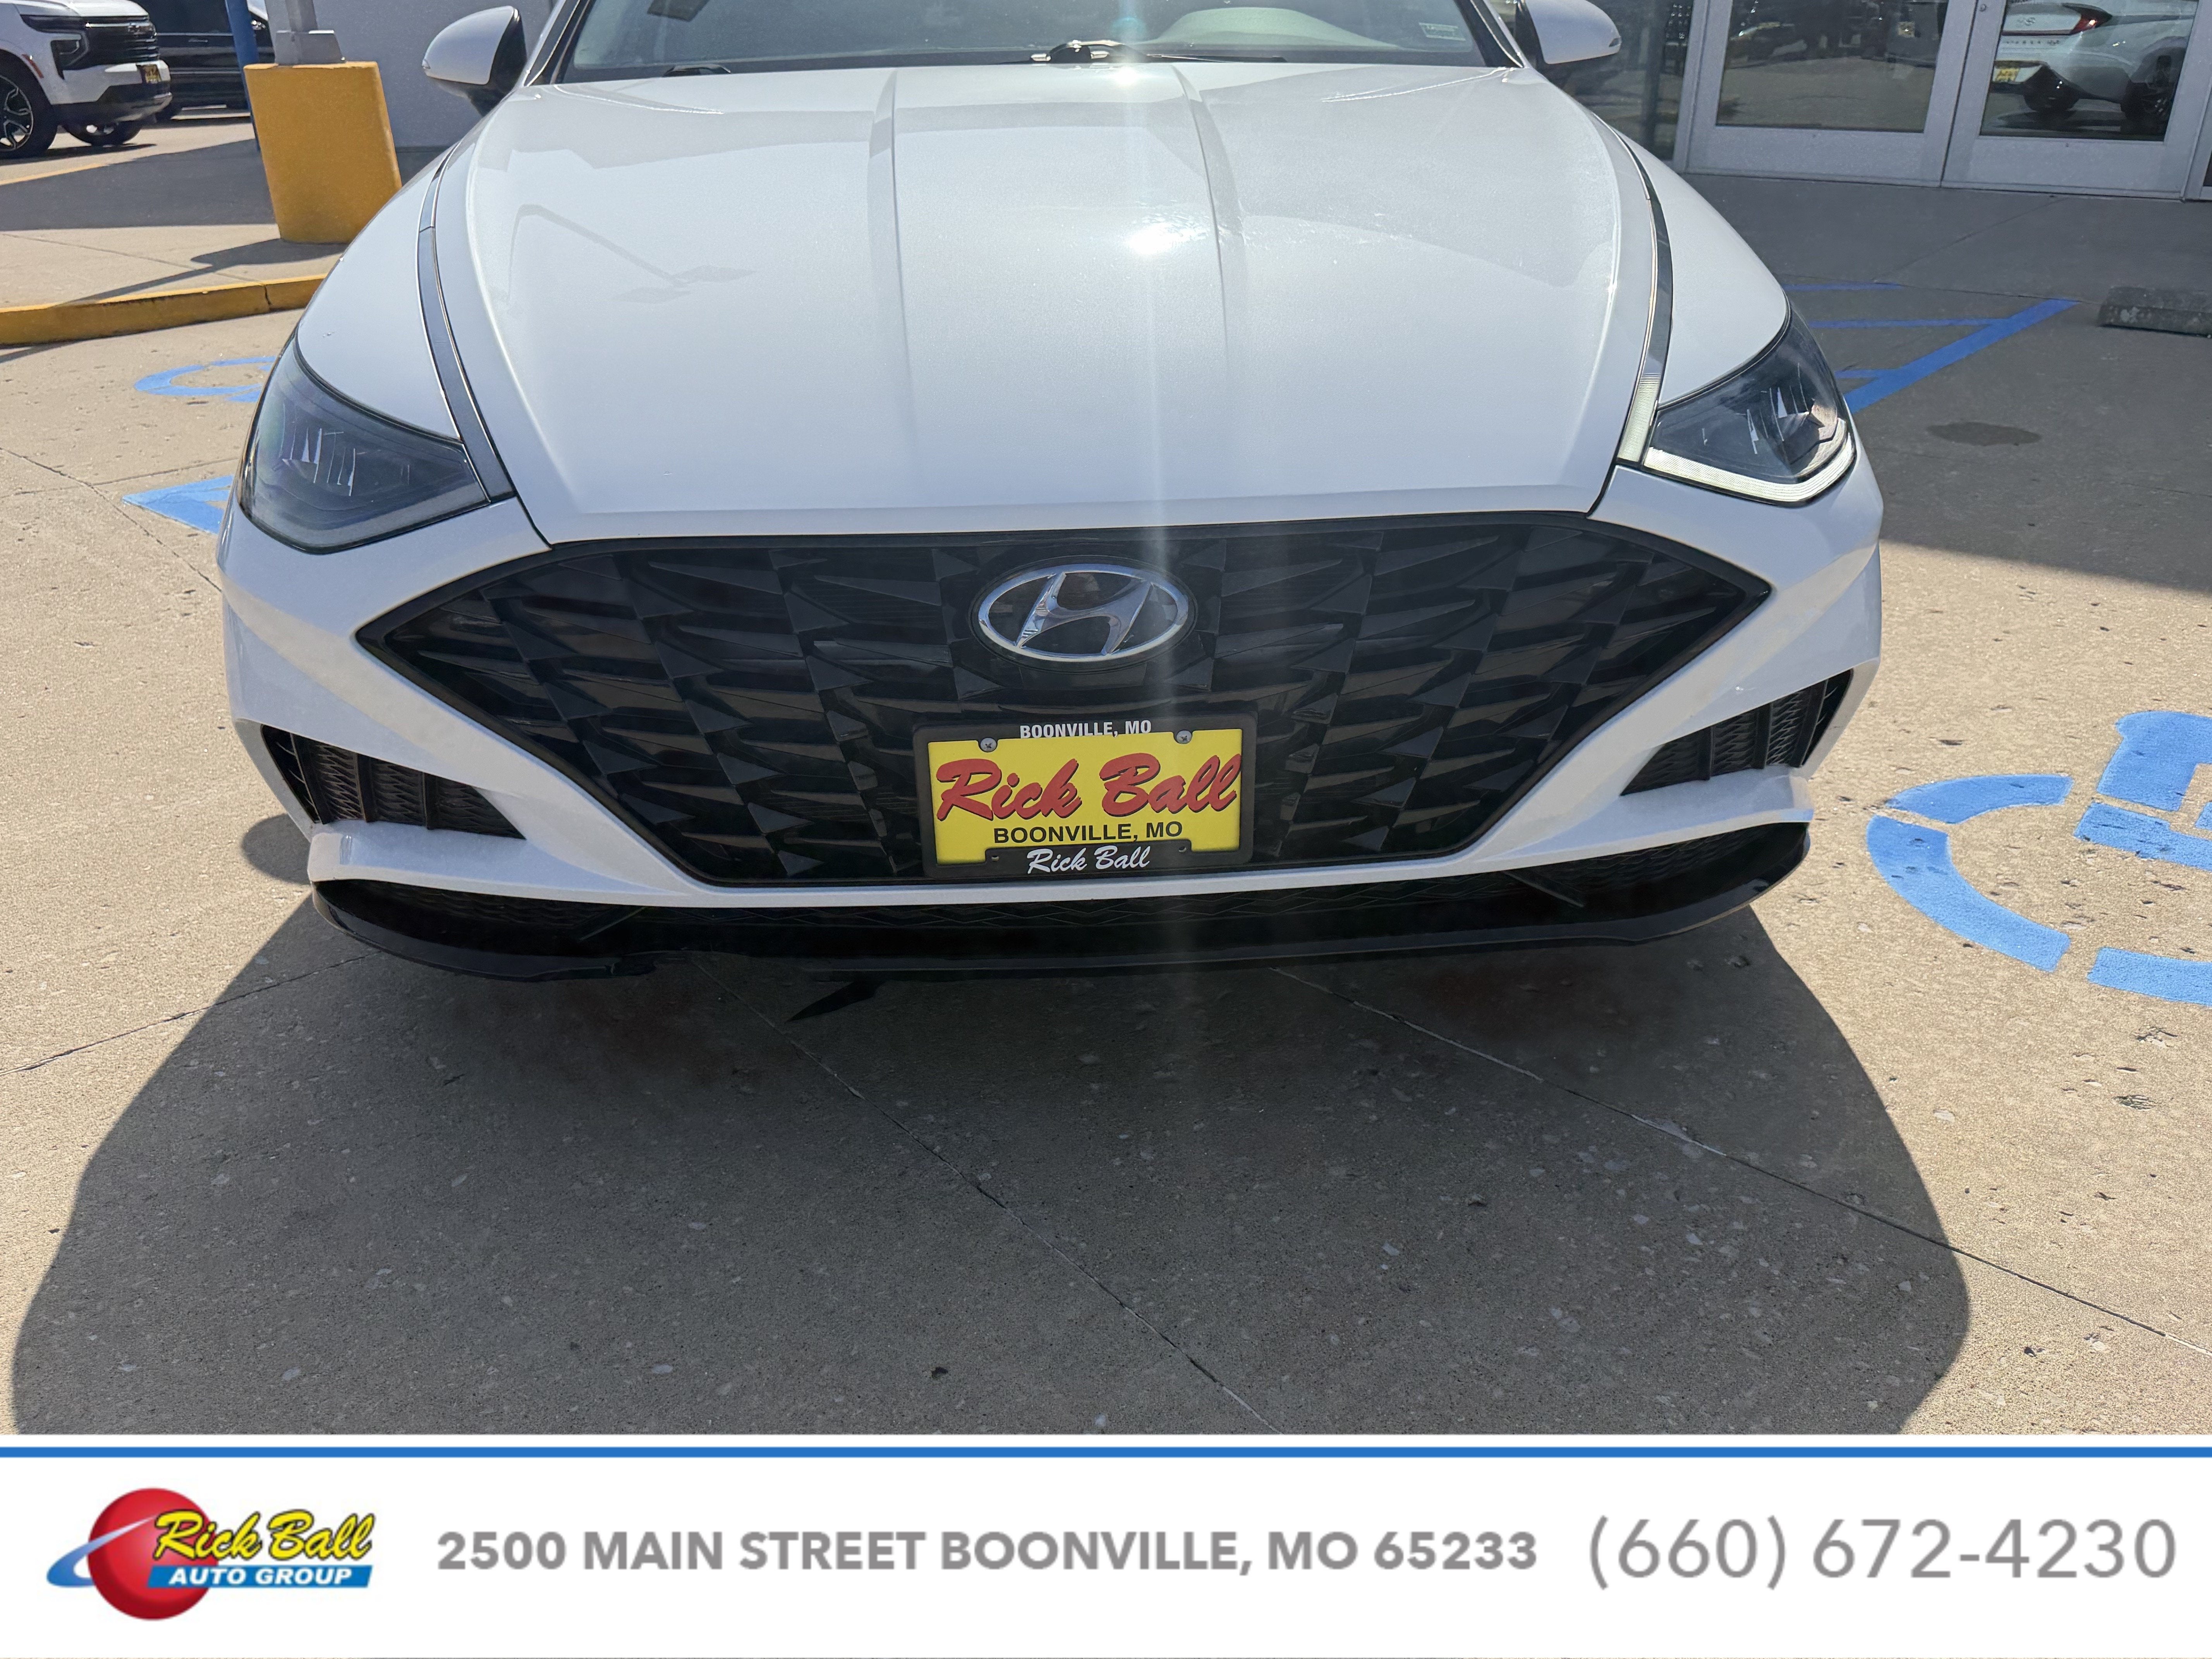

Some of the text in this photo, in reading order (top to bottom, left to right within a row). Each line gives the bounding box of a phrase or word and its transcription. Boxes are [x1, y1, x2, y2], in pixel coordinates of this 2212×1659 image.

[1020, 720, 1151, 738] BOONVILLE, MO
[936, 753, 1242, 821] Rick Ball
[994, 821, 1183, 843] BOONVILLE, MO
[1026, 845, 1151, 874] Rick Ball
